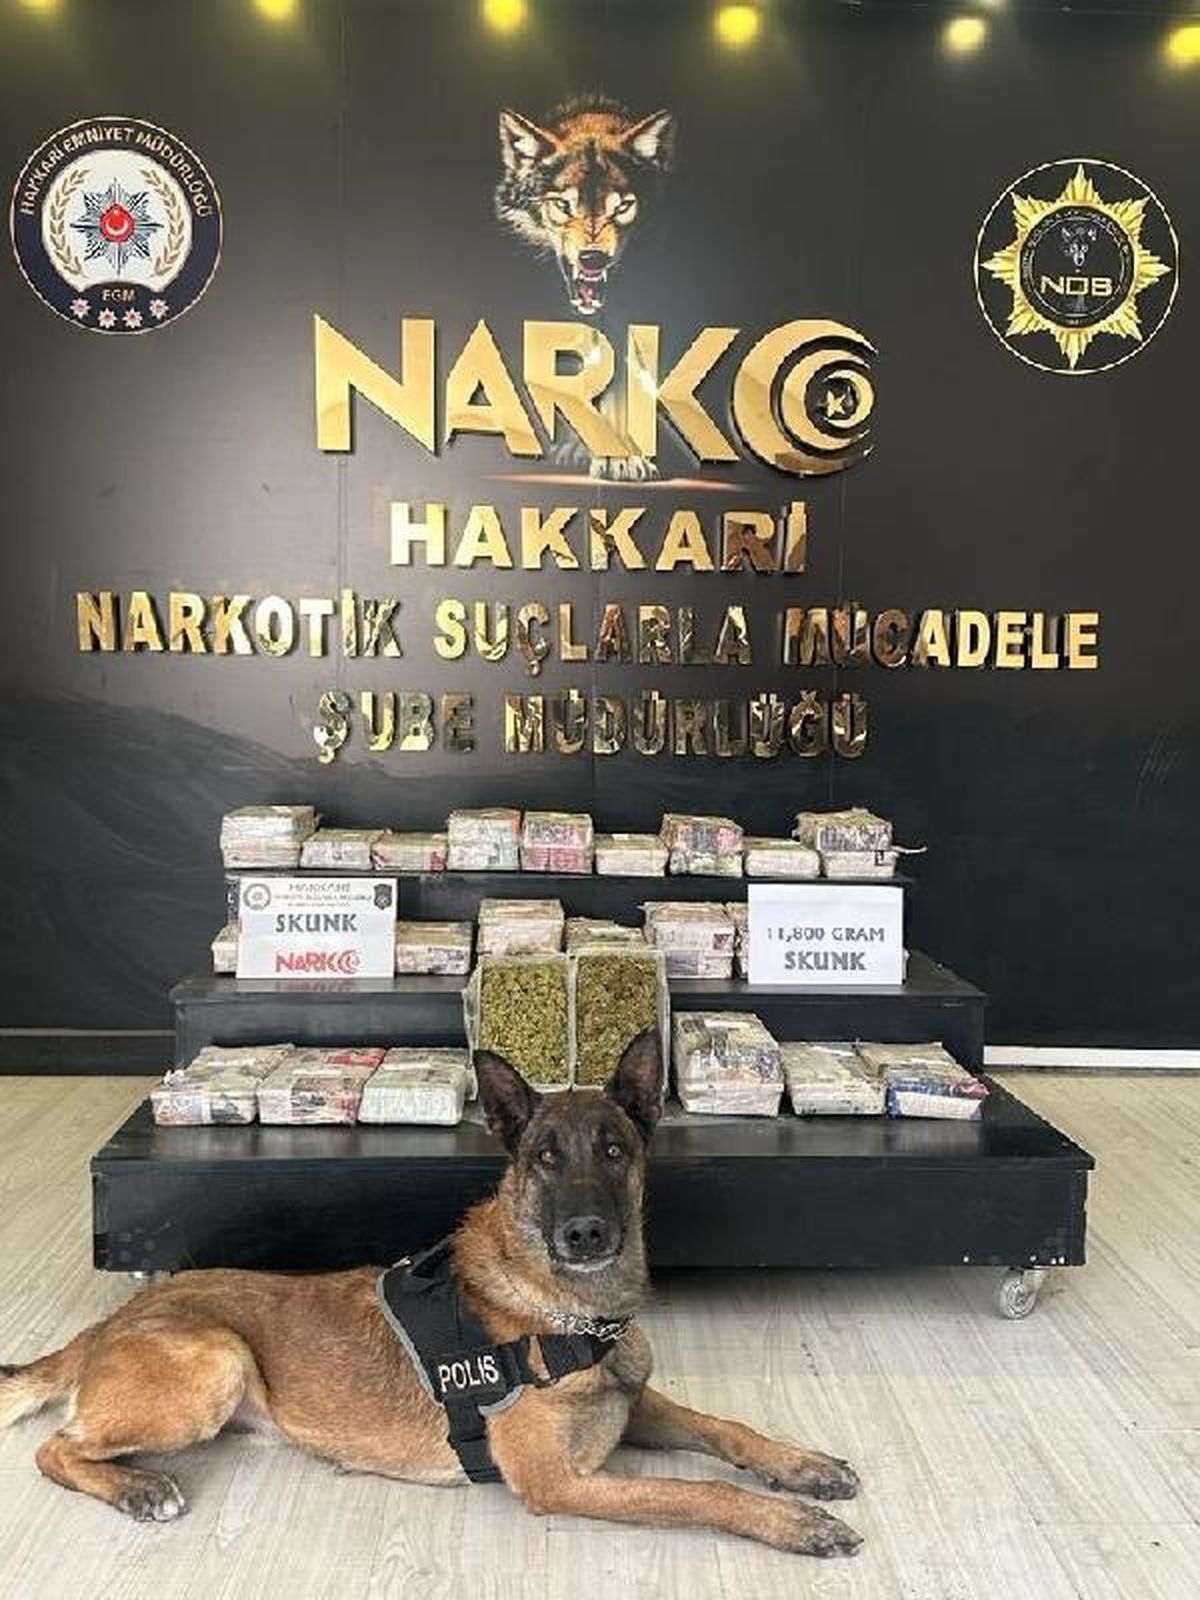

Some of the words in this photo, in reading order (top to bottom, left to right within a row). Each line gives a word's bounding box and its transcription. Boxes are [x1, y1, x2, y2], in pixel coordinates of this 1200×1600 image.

[389, 500, 808, 573] HAKKARİ
[77, 588, 402, 659] NARKOTİK
[434, 600, 753, 676] SUÇLARLA
[313, 690, 475, 764] ŞUBE
[275, 913, 358, 933] SKUNK
[831, 927, 885, 942] GRAM
[784, 951, 867, 971] SKUNK
